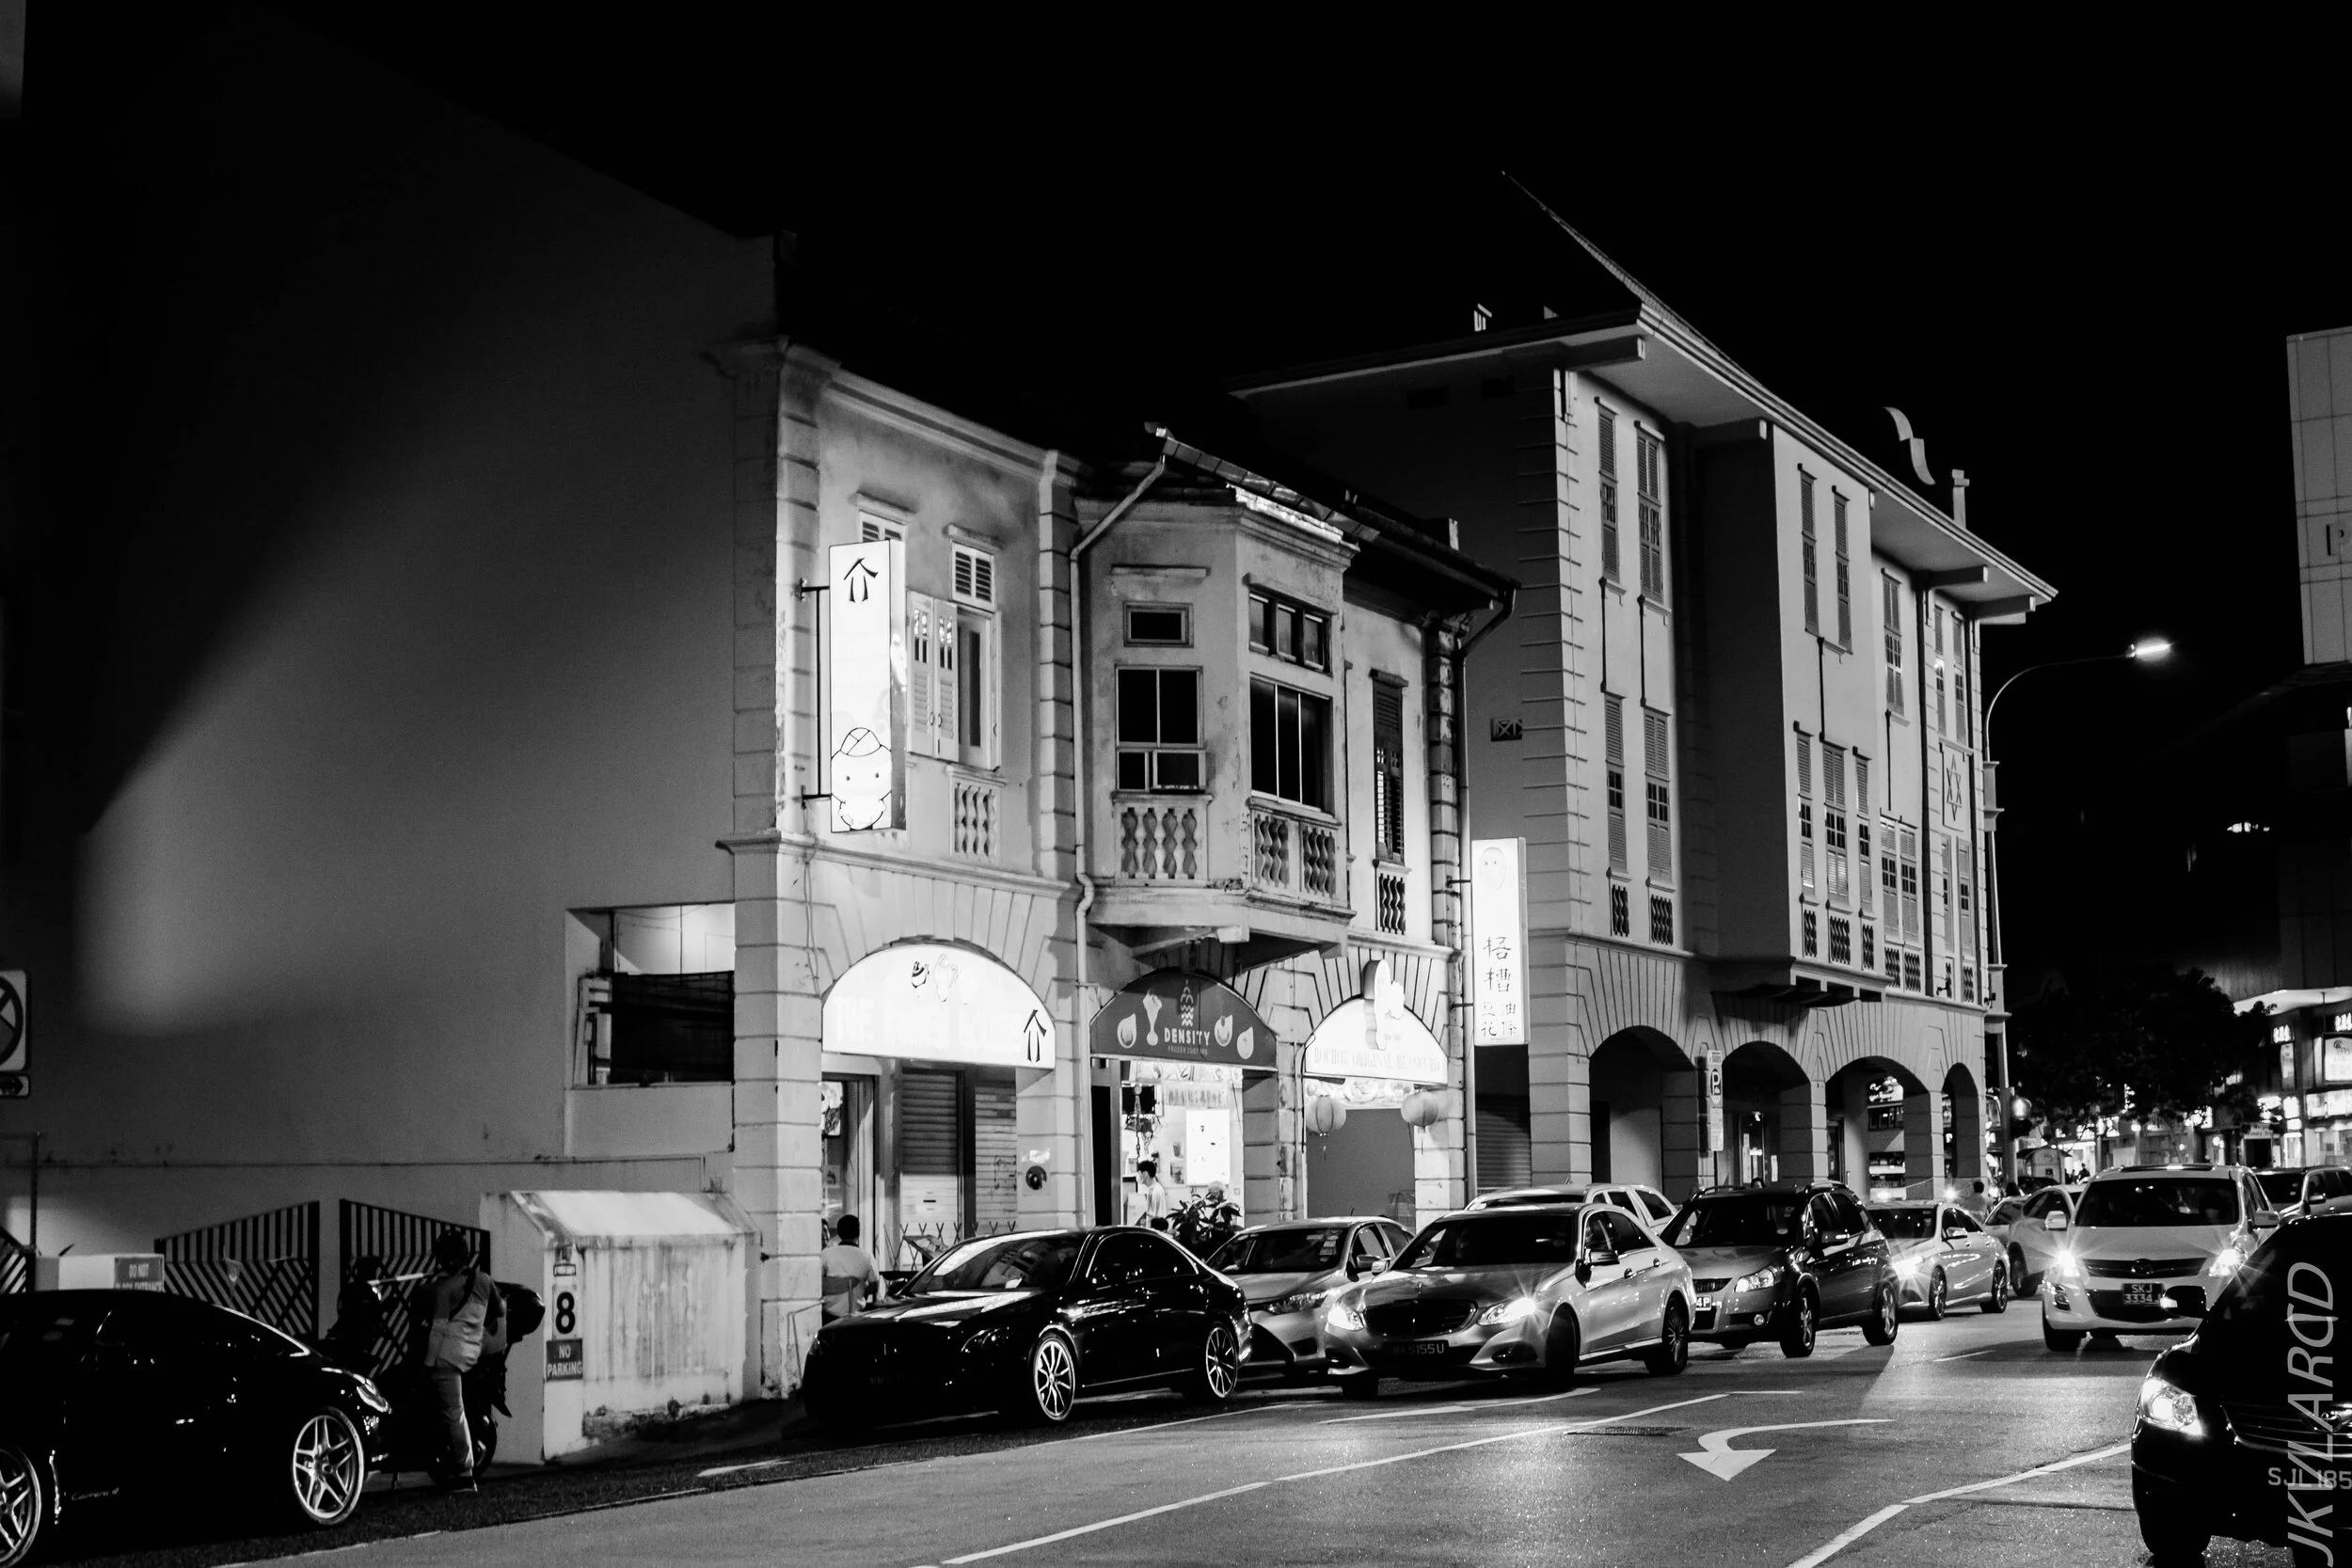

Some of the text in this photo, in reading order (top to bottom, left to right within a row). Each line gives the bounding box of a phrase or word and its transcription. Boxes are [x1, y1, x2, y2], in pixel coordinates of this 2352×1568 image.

[1164, 1027, 1211, 1046] DENSITY
[2131, 1284, 2153, 1293] SKJ
[555, 1291, 576, 1335] 8
[559, 1345, 571, 1359] NO
[547, 1361, 583, 1377] PARKING
